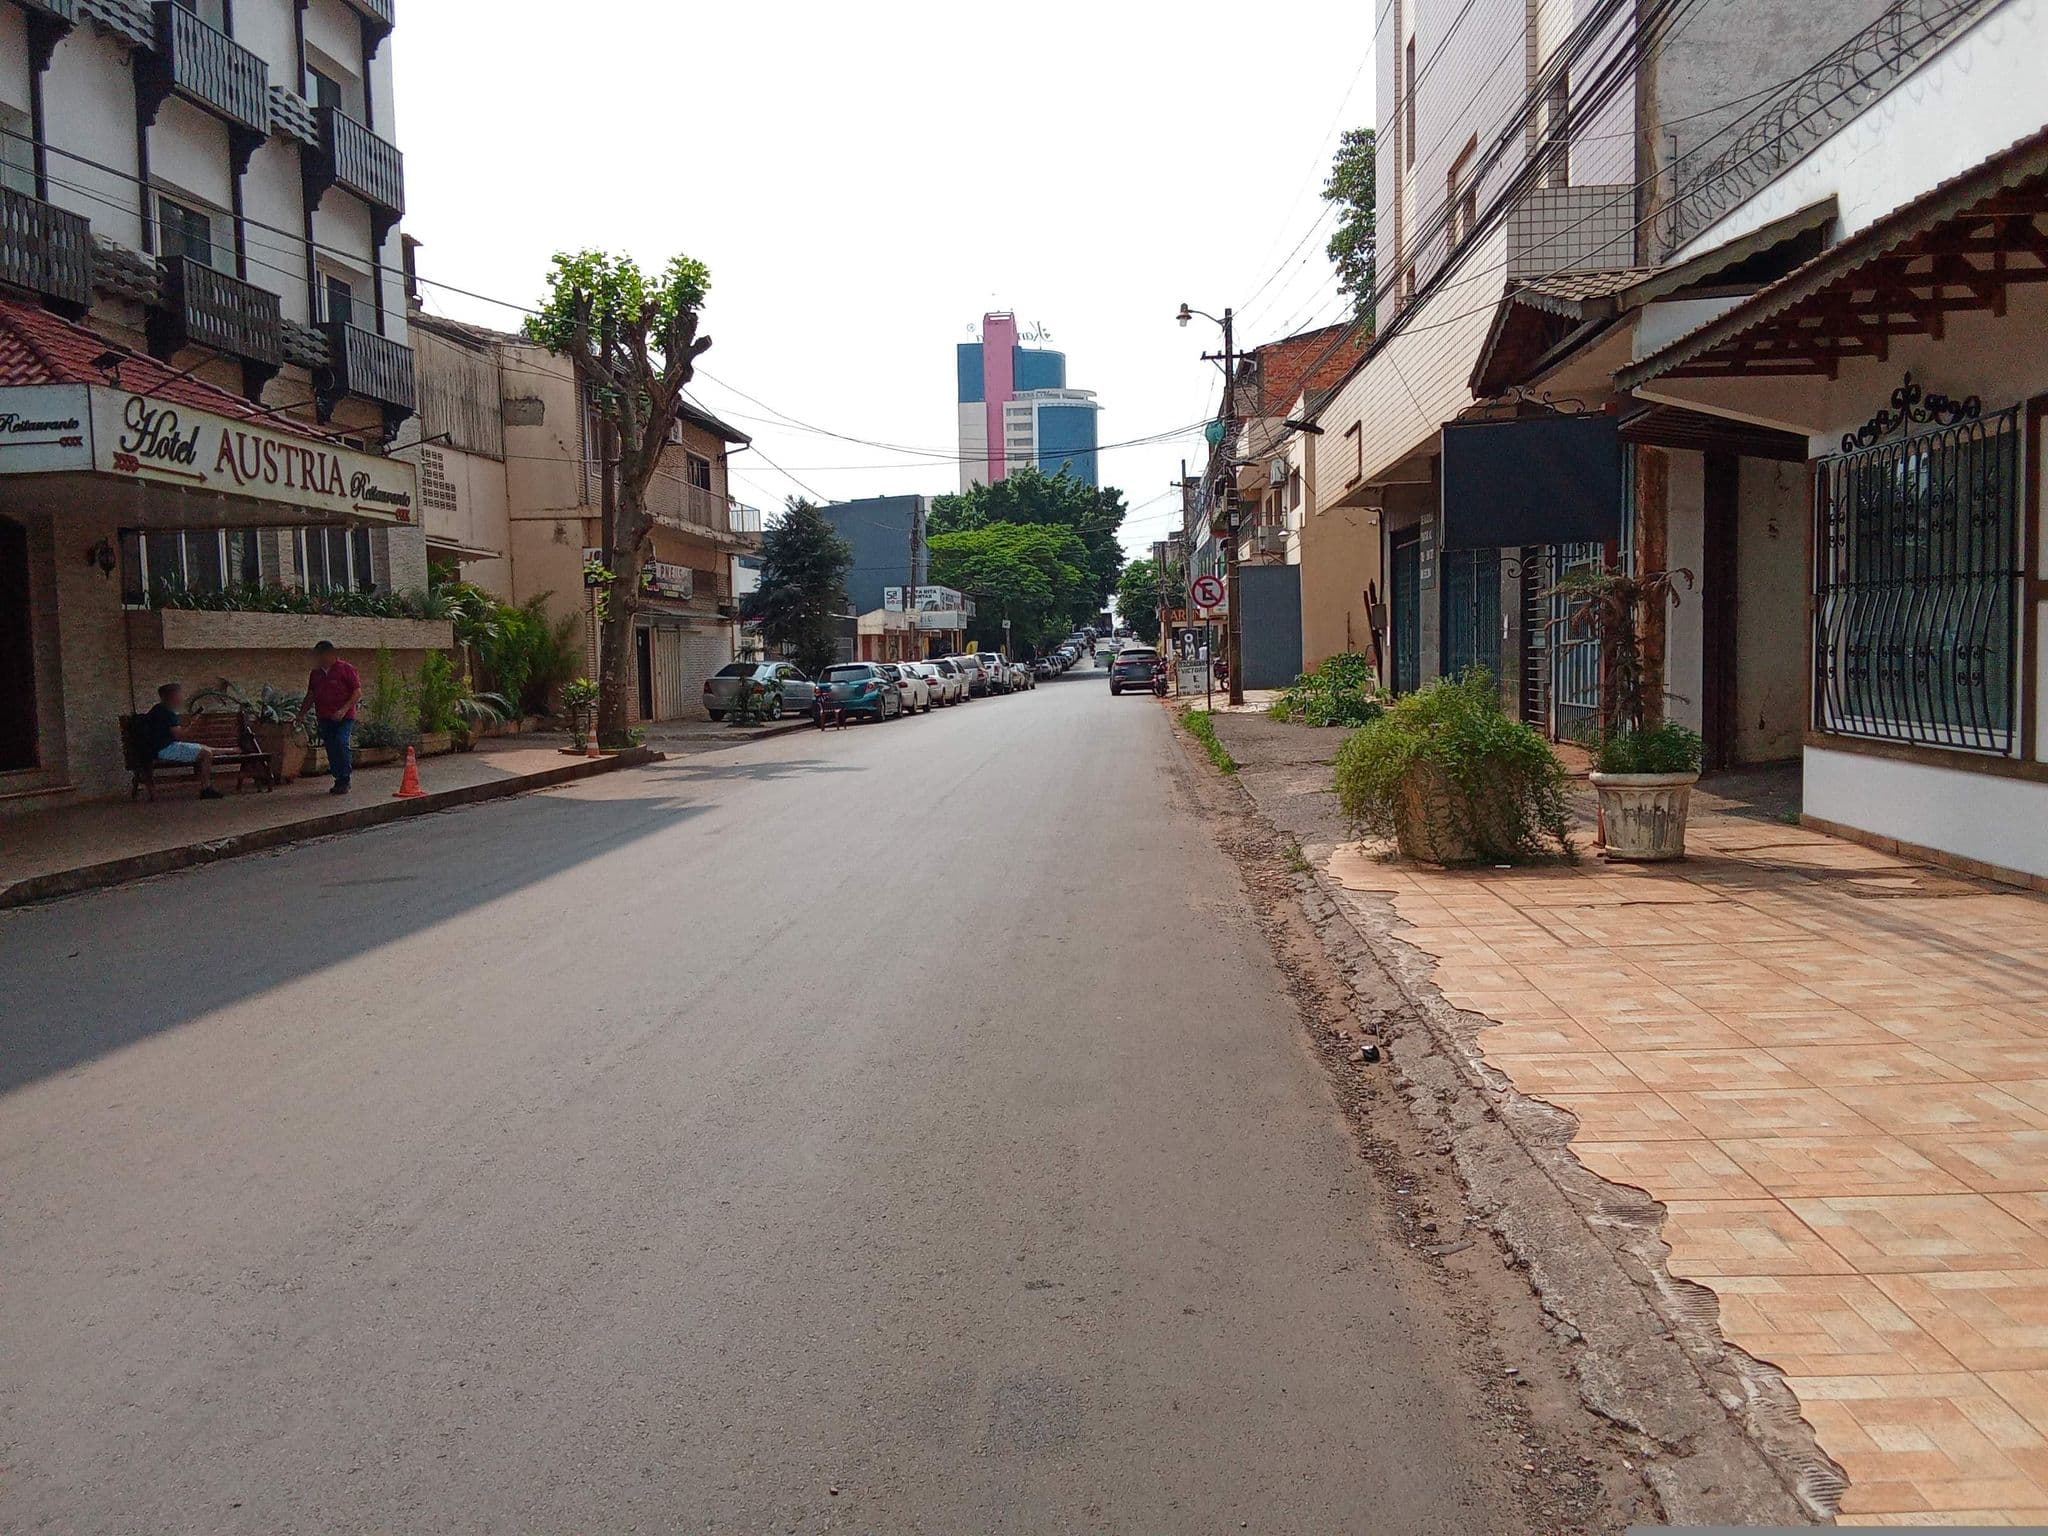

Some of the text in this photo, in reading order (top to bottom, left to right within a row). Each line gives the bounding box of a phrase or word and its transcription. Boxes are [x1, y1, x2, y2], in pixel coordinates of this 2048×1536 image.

[120, 396, 411, 507] Hotel AUSTRIA Restaurante
